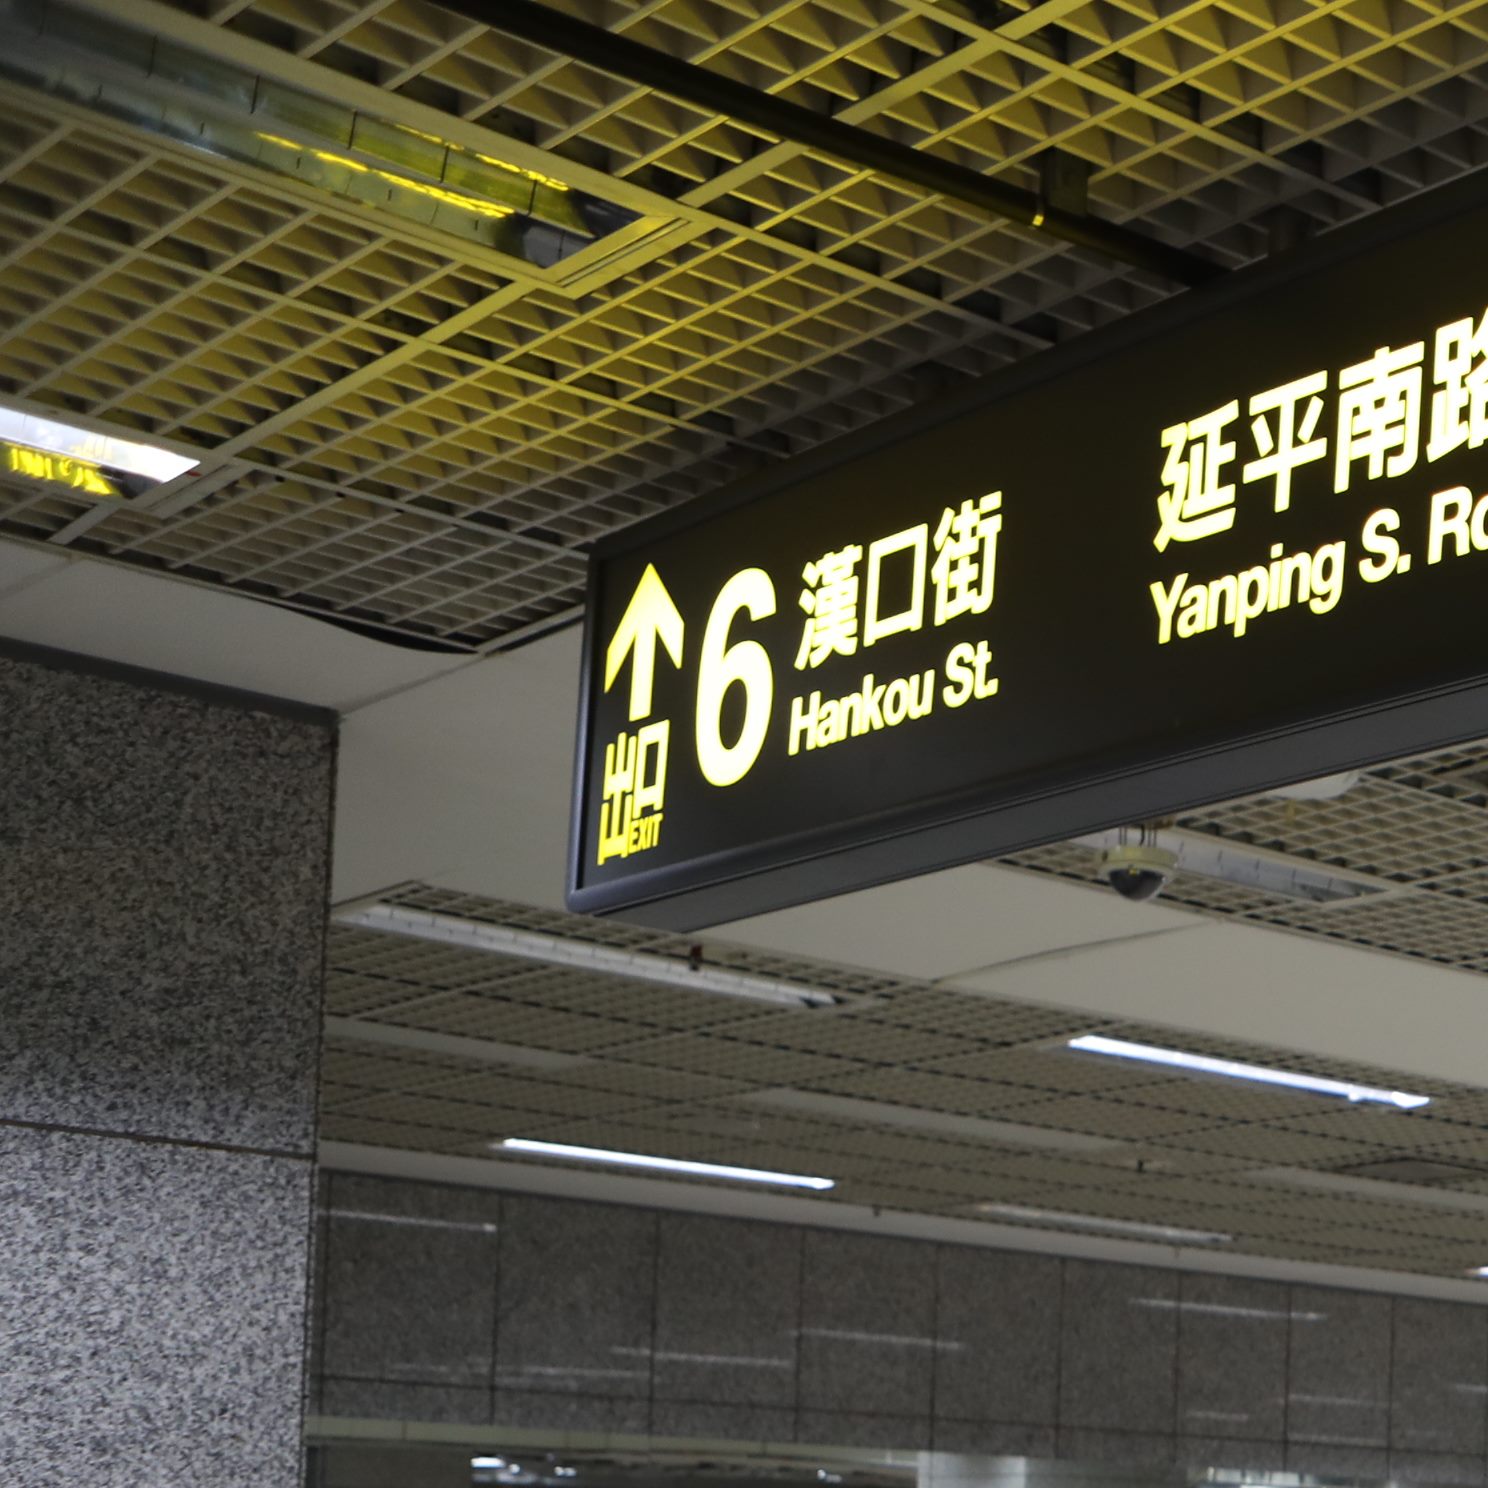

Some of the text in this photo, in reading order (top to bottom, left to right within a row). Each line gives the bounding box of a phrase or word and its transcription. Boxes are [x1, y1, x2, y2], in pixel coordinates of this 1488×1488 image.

[794, 490, 1003, 670] 漢口街
[1149, 541, 1346, 645] Yanping
[1358, 507, 1411, 583] S.
[695, 567, 777, 788] 6
[789, 640, 999, 756] Hankou St.
[597, 719, 671, 866] 出口
[628, 813, 664, 855] EXIT
